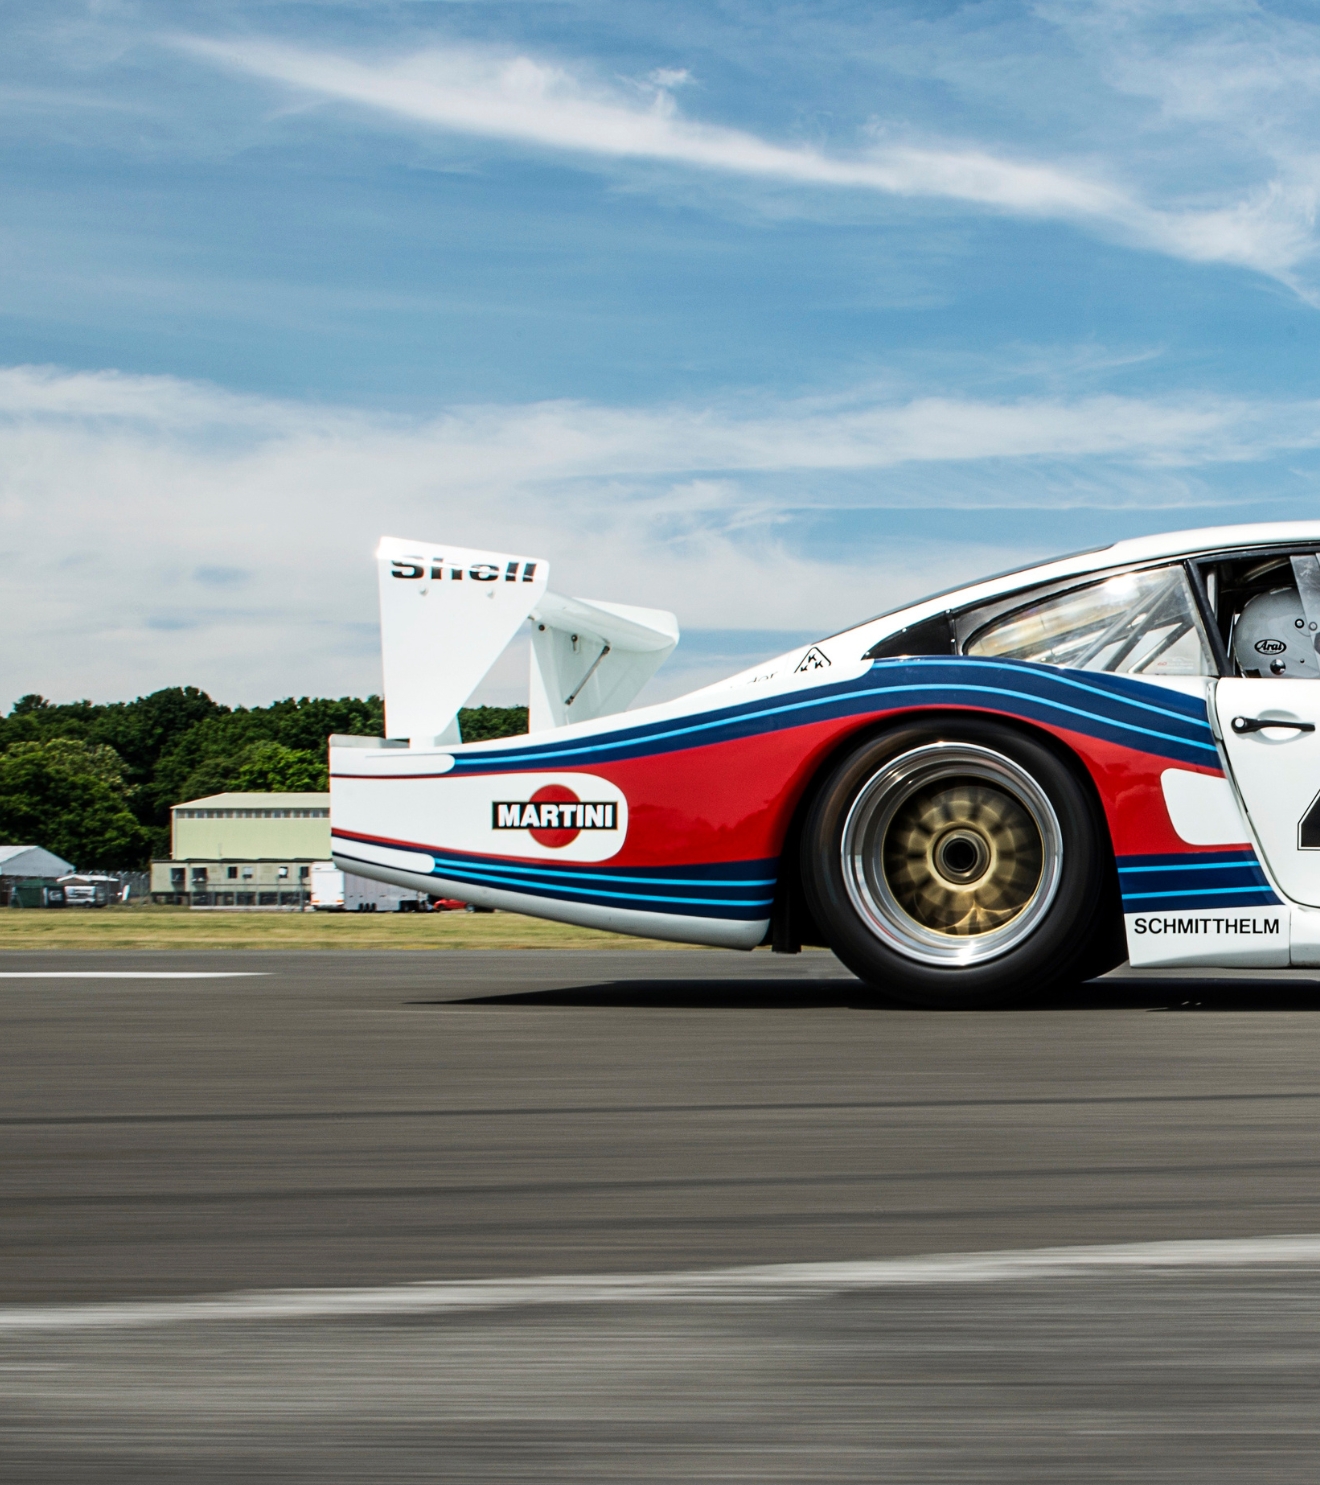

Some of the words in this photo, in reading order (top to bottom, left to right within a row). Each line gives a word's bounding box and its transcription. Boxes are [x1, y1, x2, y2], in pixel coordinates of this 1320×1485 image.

[391, 555, 537, 582] Shell
[1259, 640, 1283, 651] Arai
[498, 804, 613, 828] MARTINI
[1134, 918, 1280, 934] SCHMITTHELM
